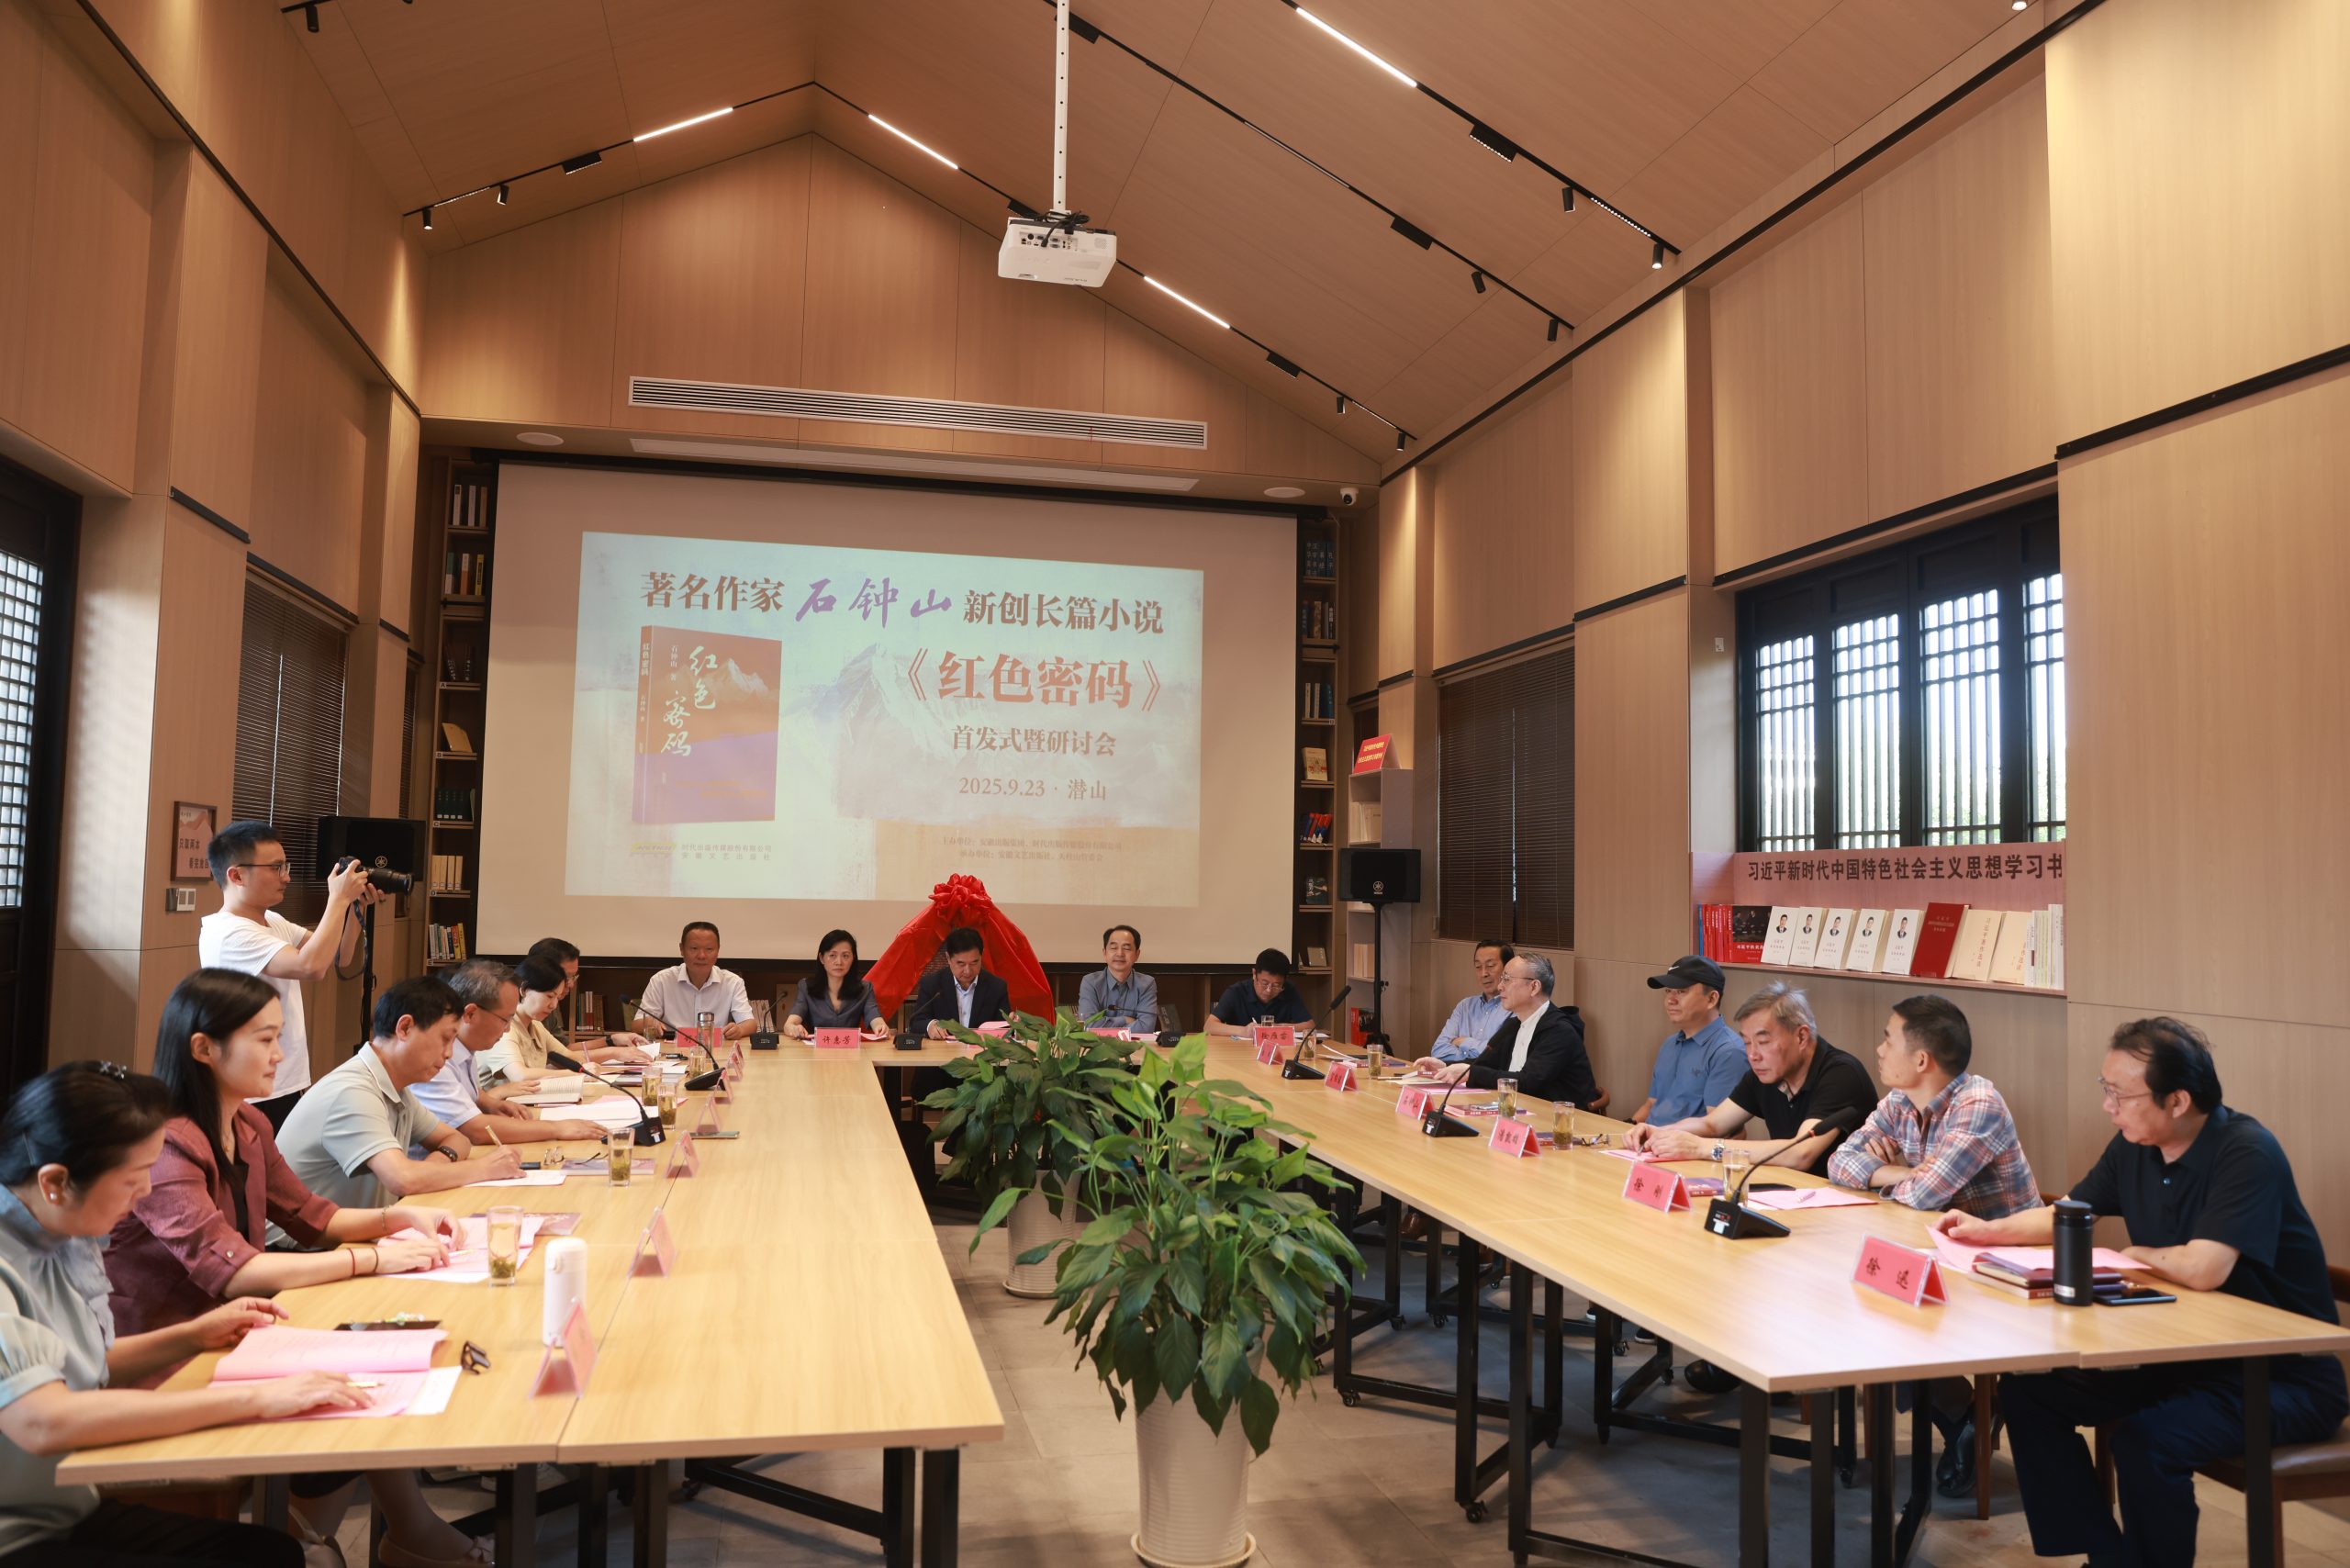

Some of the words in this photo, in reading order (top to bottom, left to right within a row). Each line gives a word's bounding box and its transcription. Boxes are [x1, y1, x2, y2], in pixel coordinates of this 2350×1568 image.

[640, 572, 786, 613] 著名作家
[795, 577, 952, 629] 石钟山
[963, 589, 1164, 633] 新创长篇小说
[907, 647, 1161, 711] 《红色密码》
[951, 724, 1117, 756] 首发式暨研讨会
[1748, 853, 2063, 881] 习近平新时代中国特色社会主义思想学习书
